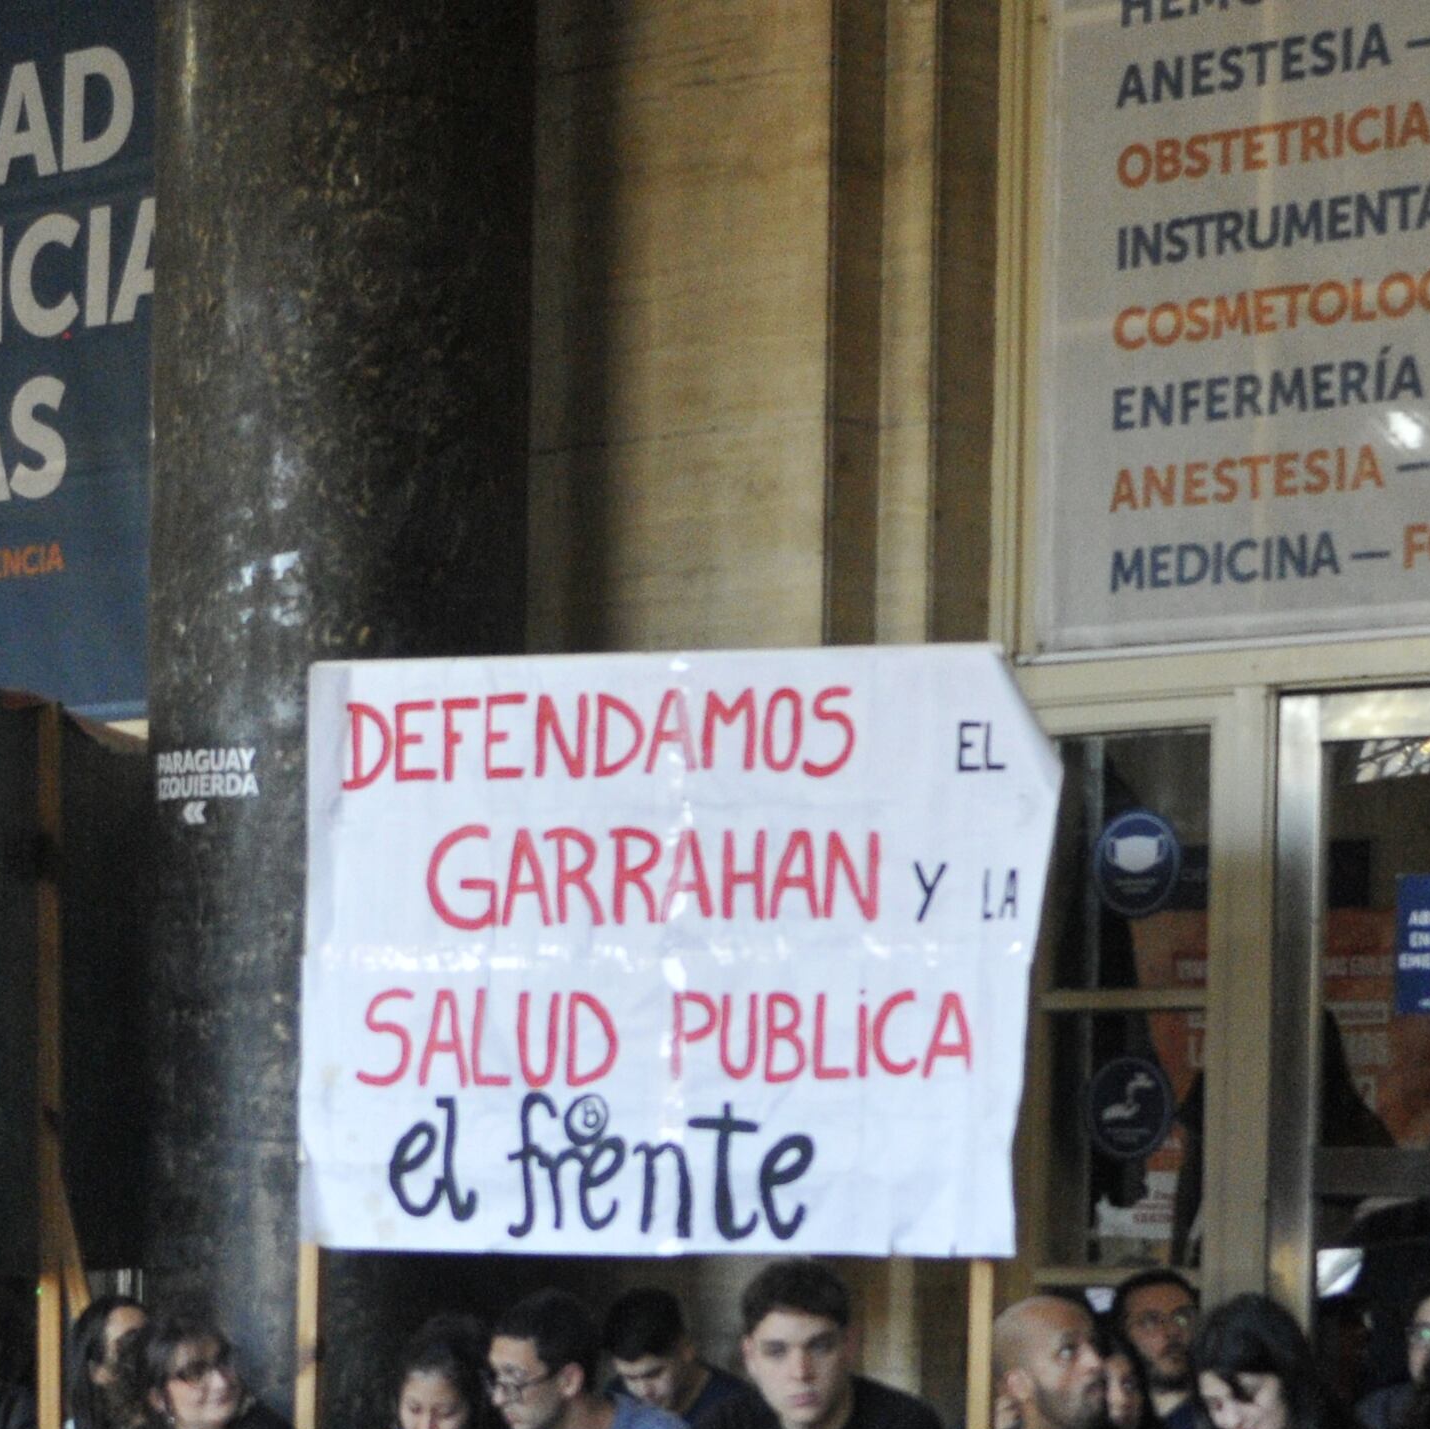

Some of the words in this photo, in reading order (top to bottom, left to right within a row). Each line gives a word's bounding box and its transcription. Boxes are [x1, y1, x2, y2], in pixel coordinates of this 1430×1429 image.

[1116, 22, 1392, 109] ANESTESIA
[1112, 346, 1424, 432] ENFERMERÍA
[1109, 444, 1385, 512] ANESTESIA
[1109, 530, 1341, 594] MEDICINA
[157, 748, 256, 774] PARAGUAY
[341, 686, 855, 791] DEFENDAMOS
[956, 722, 1006, 772] EL
[158, 773, 260, 800] IZQUIERDA
[426, 825, 881, 930] GARRAHAN
[912, 861, 947, 922] Y
[982, 868, 1019, 922] LA
[1409, 931, 1430, 948] EN
[356, 989, 618, 1088] SALUD
[389, 1097, 476, 1222] el
[507, 1090, 815, 1240] frente
